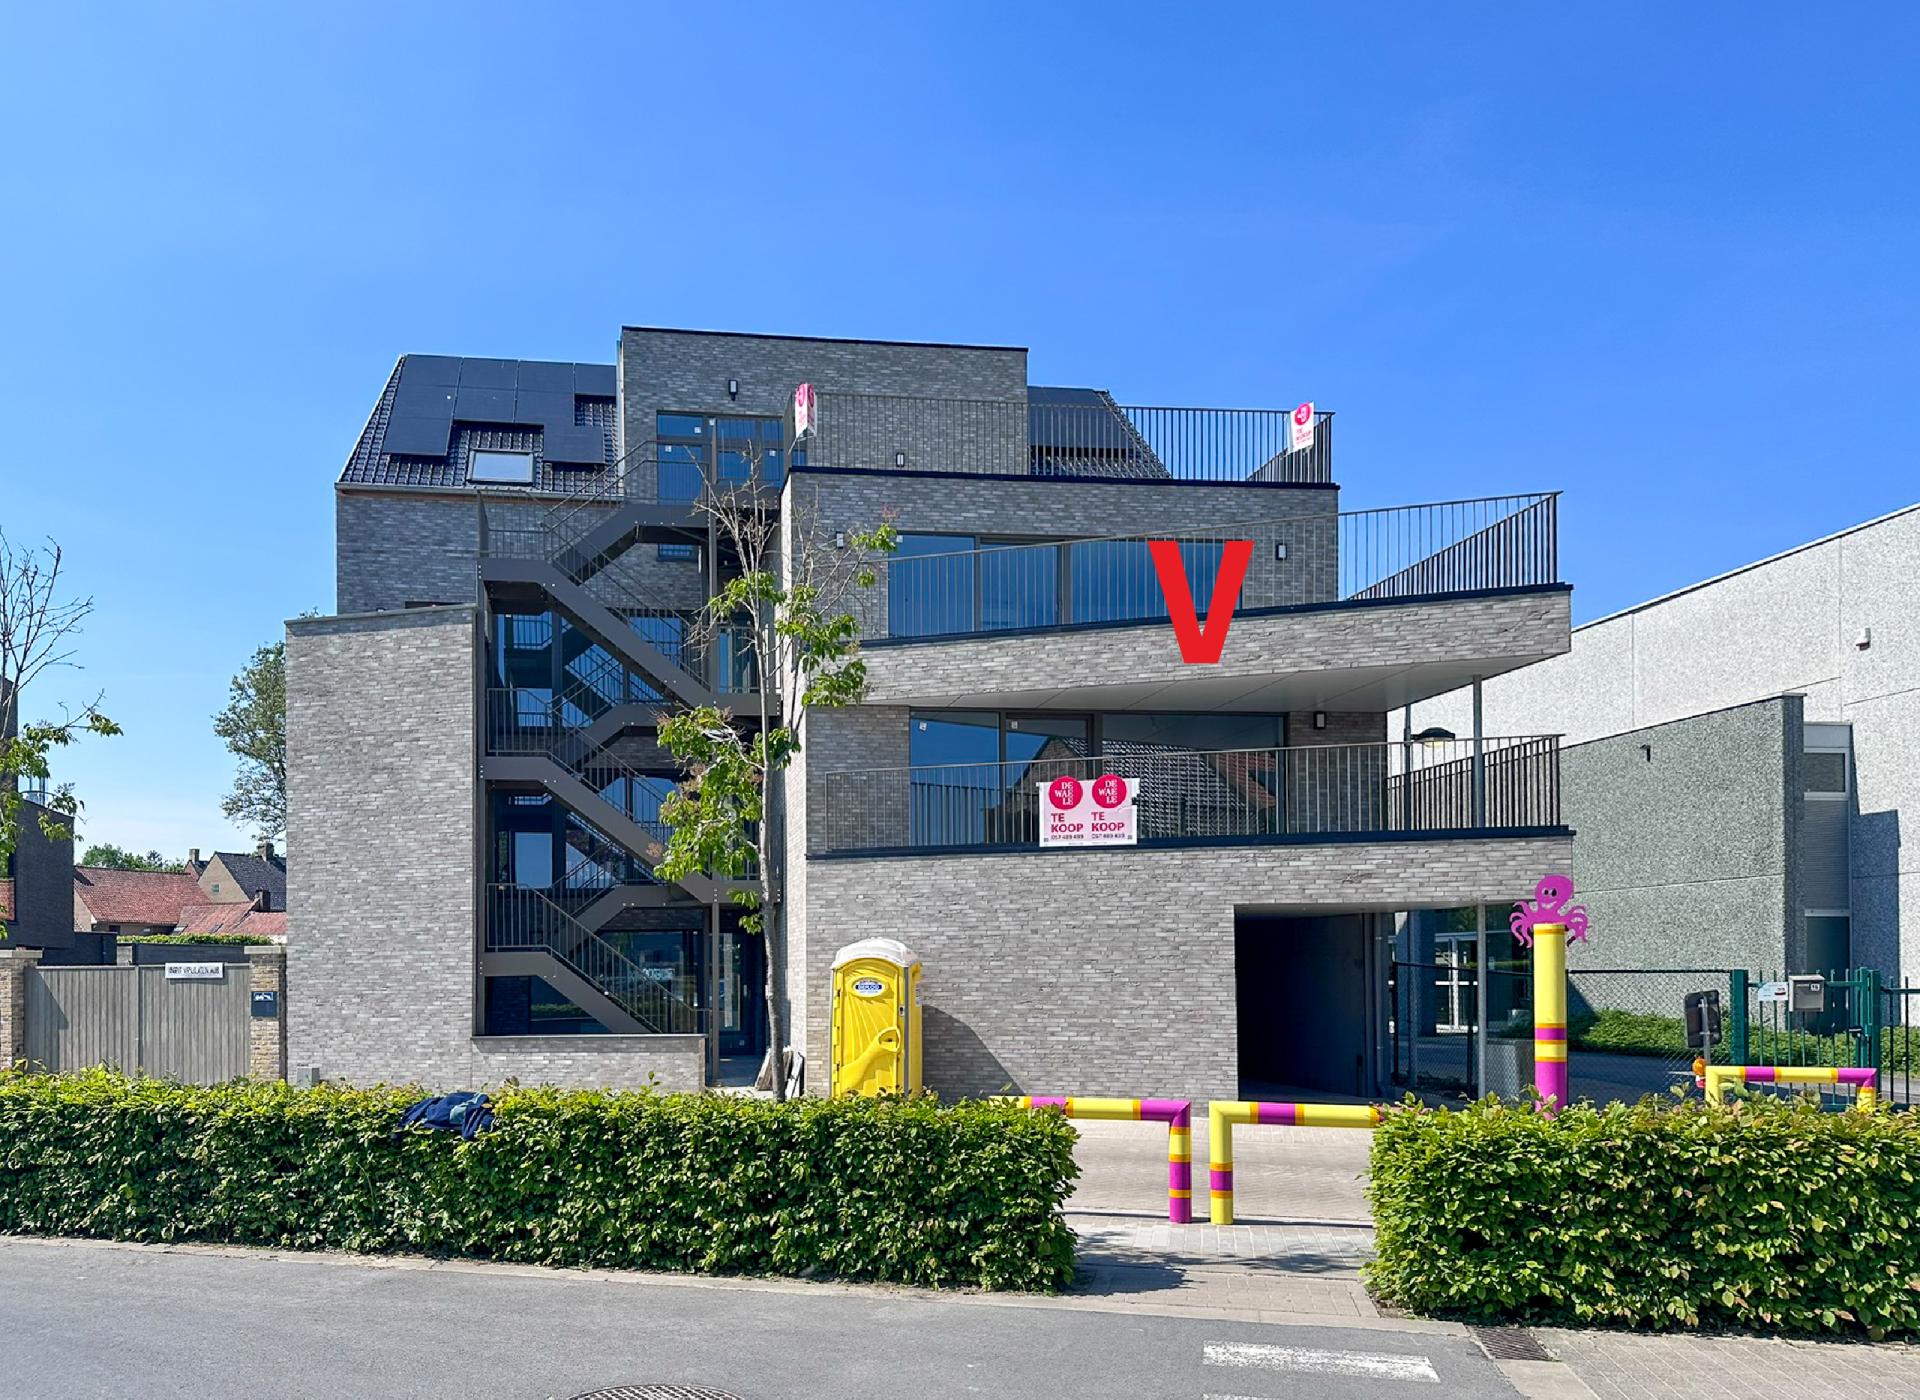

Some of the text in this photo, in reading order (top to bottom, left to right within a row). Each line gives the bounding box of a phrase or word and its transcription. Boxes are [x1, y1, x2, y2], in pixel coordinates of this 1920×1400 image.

[1061, 782, 1073, 790] DE
[1105, 779, 1118, 788] DE
[1054, 790, 1073, 798] WAE
[1098, 787, 1118, 796] WAE
[1062, 798, 1073, 806] LE
[1106, 796, 1118, 804] LE
[1051, 813, 1065, 823] TE
[1091, 811, 1105, 821] TE
[1051, 823, 1084, 833] KOOP
[1091, 822, 1125, 832] KOOP
